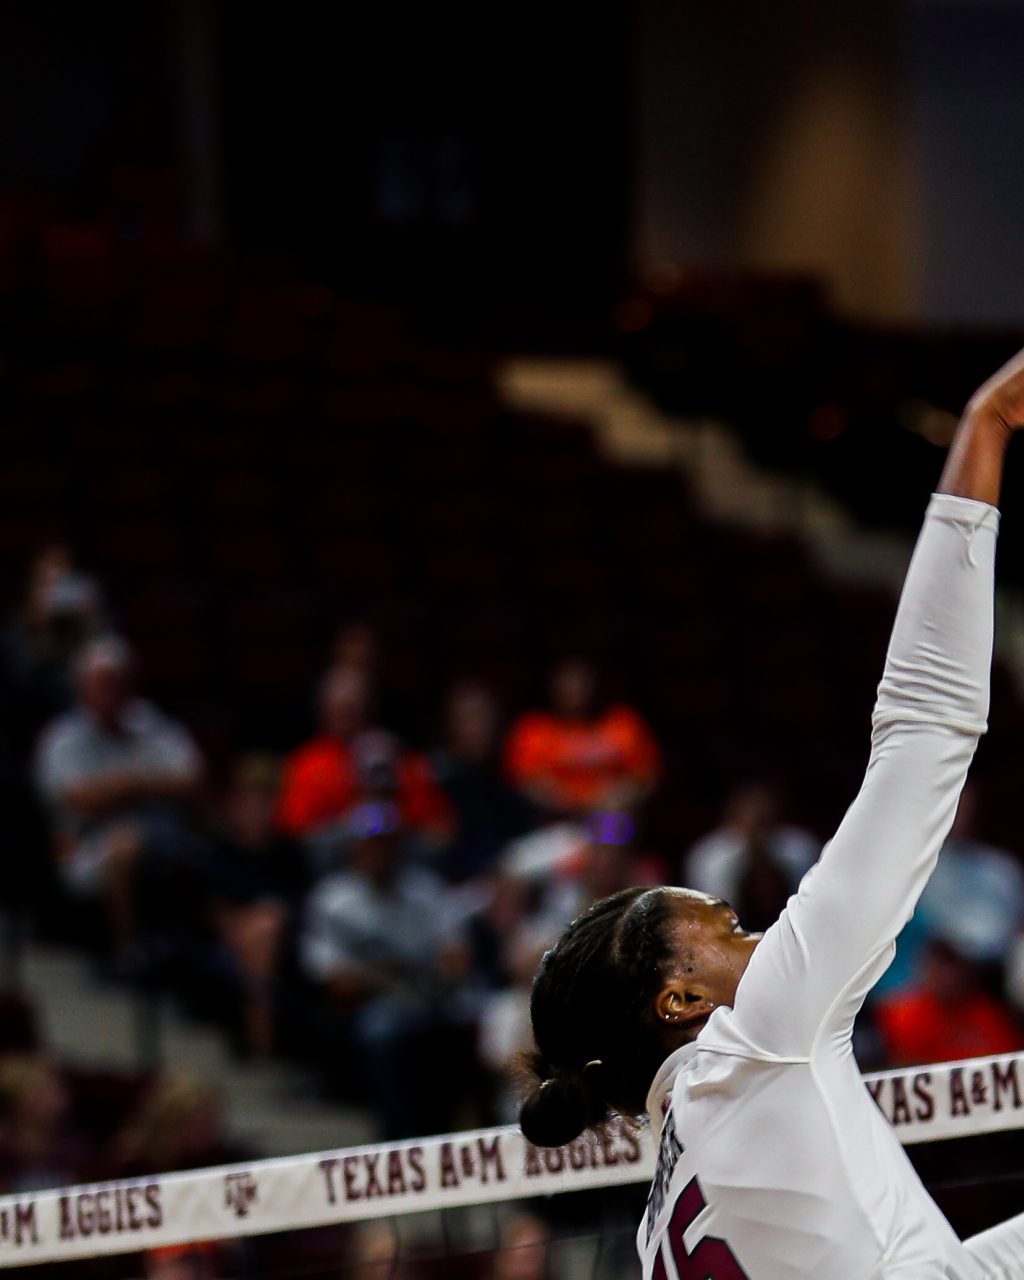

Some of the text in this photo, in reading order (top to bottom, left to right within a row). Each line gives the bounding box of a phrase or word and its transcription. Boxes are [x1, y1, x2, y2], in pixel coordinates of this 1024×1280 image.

[949, 1059, 1023, 1118] A&M
[318, 1146, 427, 1205] TEXAS
[58, 1183, 163, 1242] AGGIES
